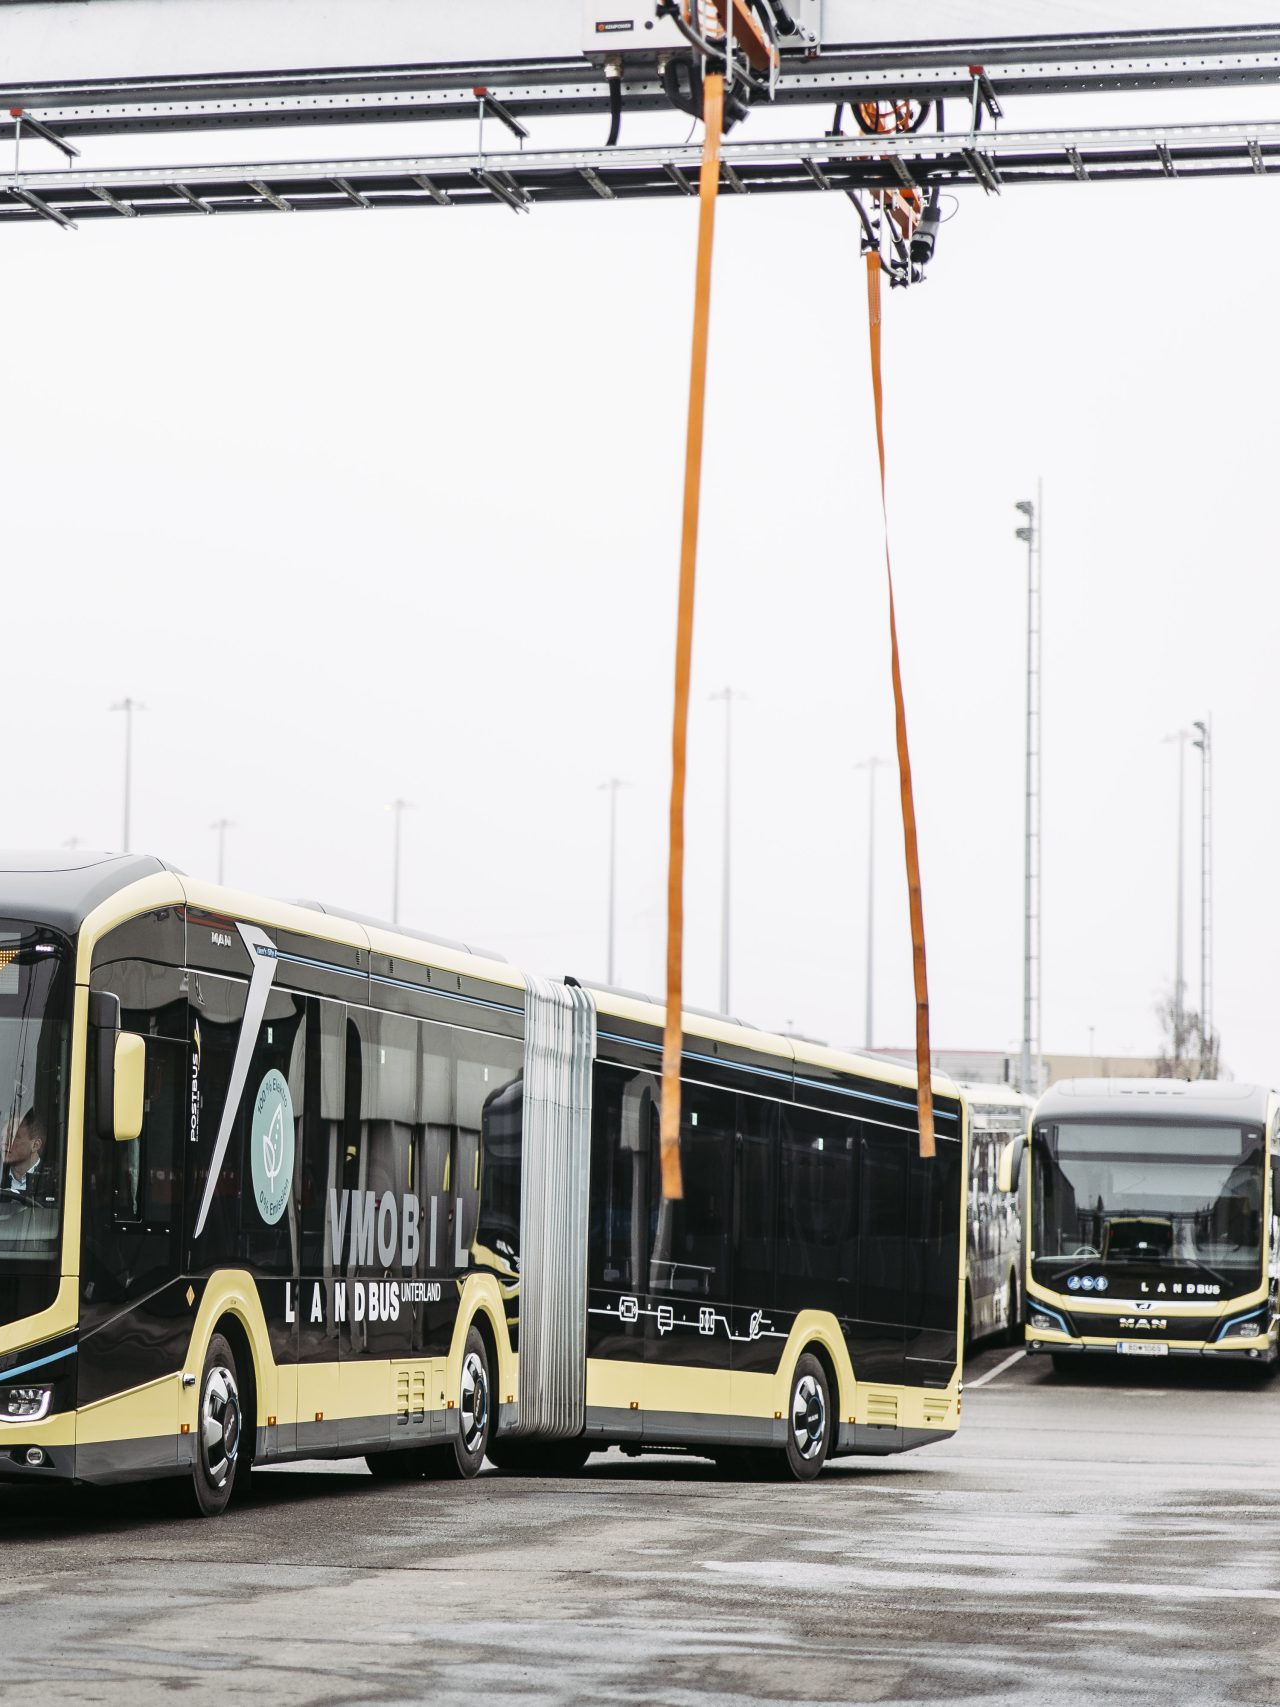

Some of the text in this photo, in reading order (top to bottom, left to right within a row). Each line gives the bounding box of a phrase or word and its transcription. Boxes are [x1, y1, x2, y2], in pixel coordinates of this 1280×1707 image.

[211, 931, 232, 947] MAN
[190, 1053, 199, 1142] POSTBUS
[285, 1281, 441, 1323] LANDBUS UNTERLAND
[1119, 1317, 1168, 1330] MAN
